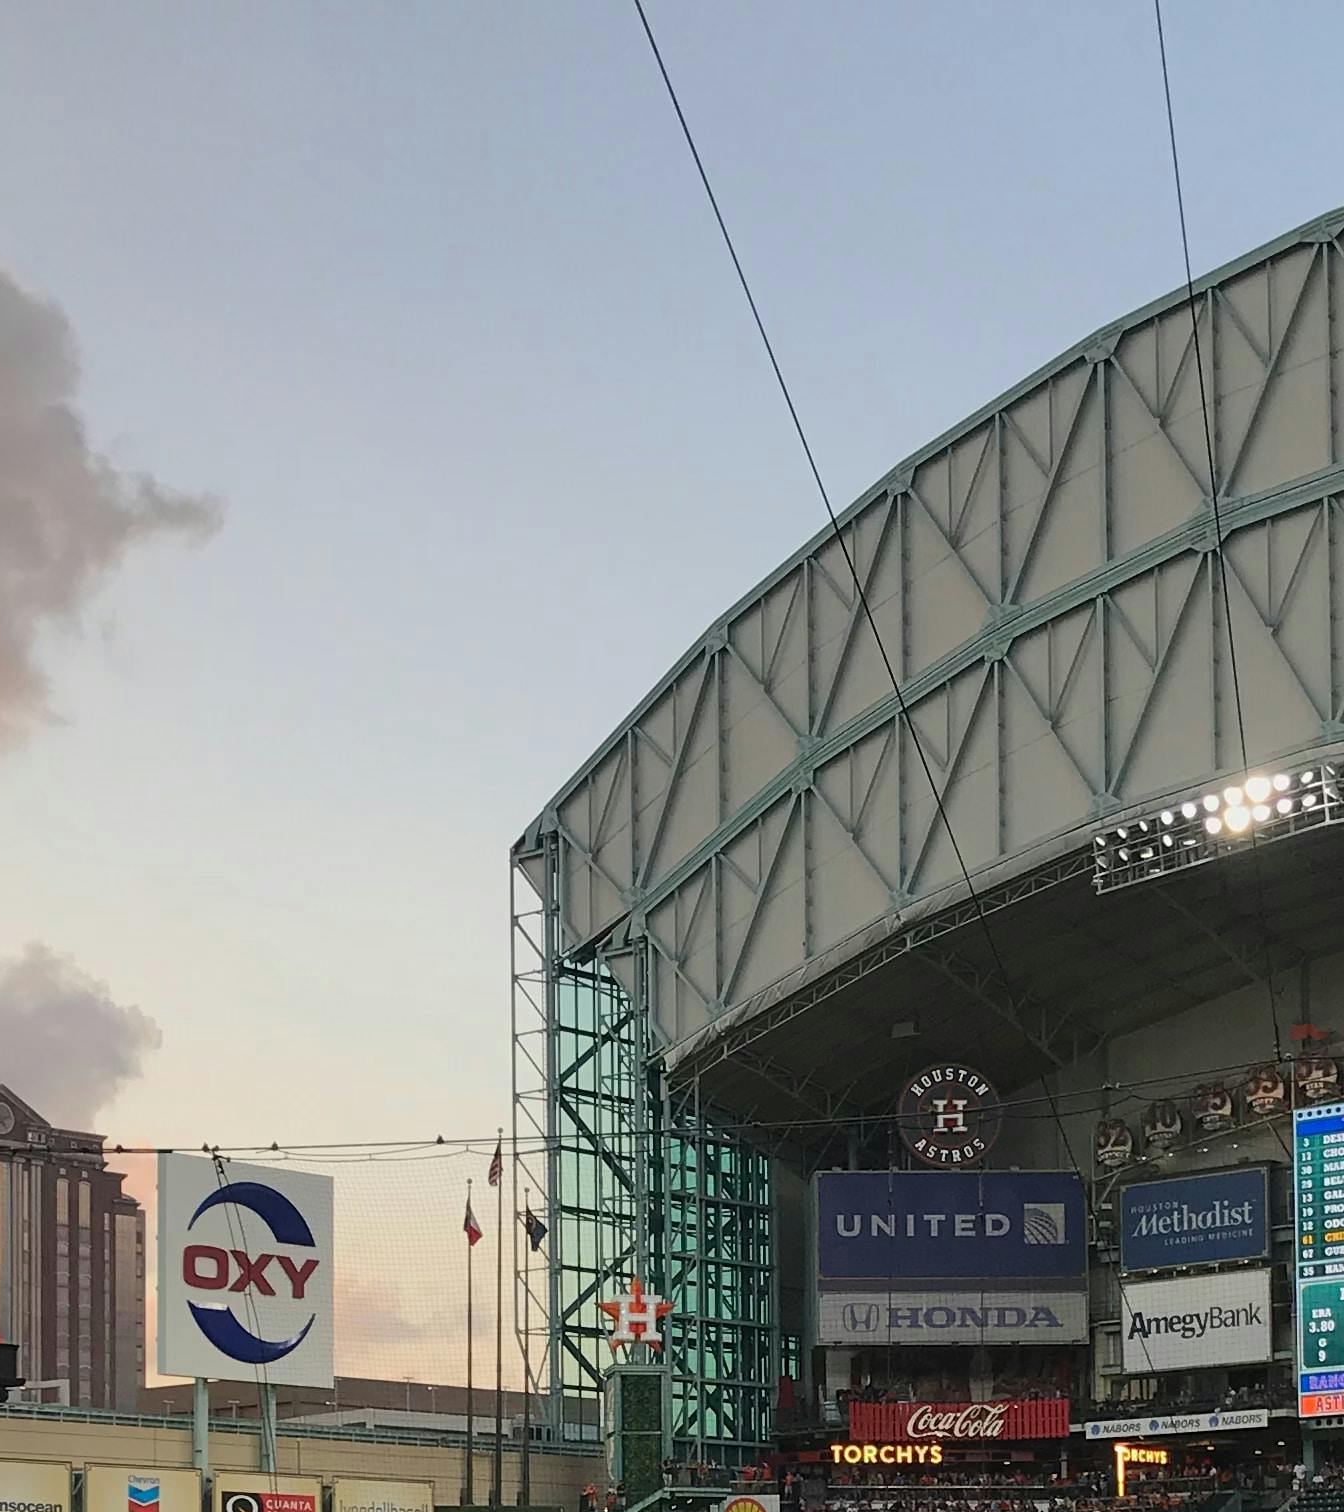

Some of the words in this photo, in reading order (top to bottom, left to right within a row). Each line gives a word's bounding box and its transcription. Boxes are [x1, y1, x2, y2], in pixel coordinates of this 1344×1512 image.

[910, 1068, 989, 1098] HOUSTON
[931, 1099, 968, 1132] H
[914, 1137, 986, 1163] ASTROS
[836, 1213, 1011, 1238] UNITED
[1131, 1199, 1253, 1239] Methodist
[183, 1244, 320, 1299] OXY
[885, 1306, 1064, 1329] HONDA
[1127, 1302, 1263, 1341] AmegyBank
[1309, 1320, 1334, 1333] 3.80
[906, 1405, 1009, 1439] Coca-Cola
[1103, 1422, 1141, 1434] NABORS
[1160, 1418, 1201, 1431] NABORS
[1221, 1413, 1263, 1426] NABORS
[831, 1445, 942, 1464] TORCHYS
